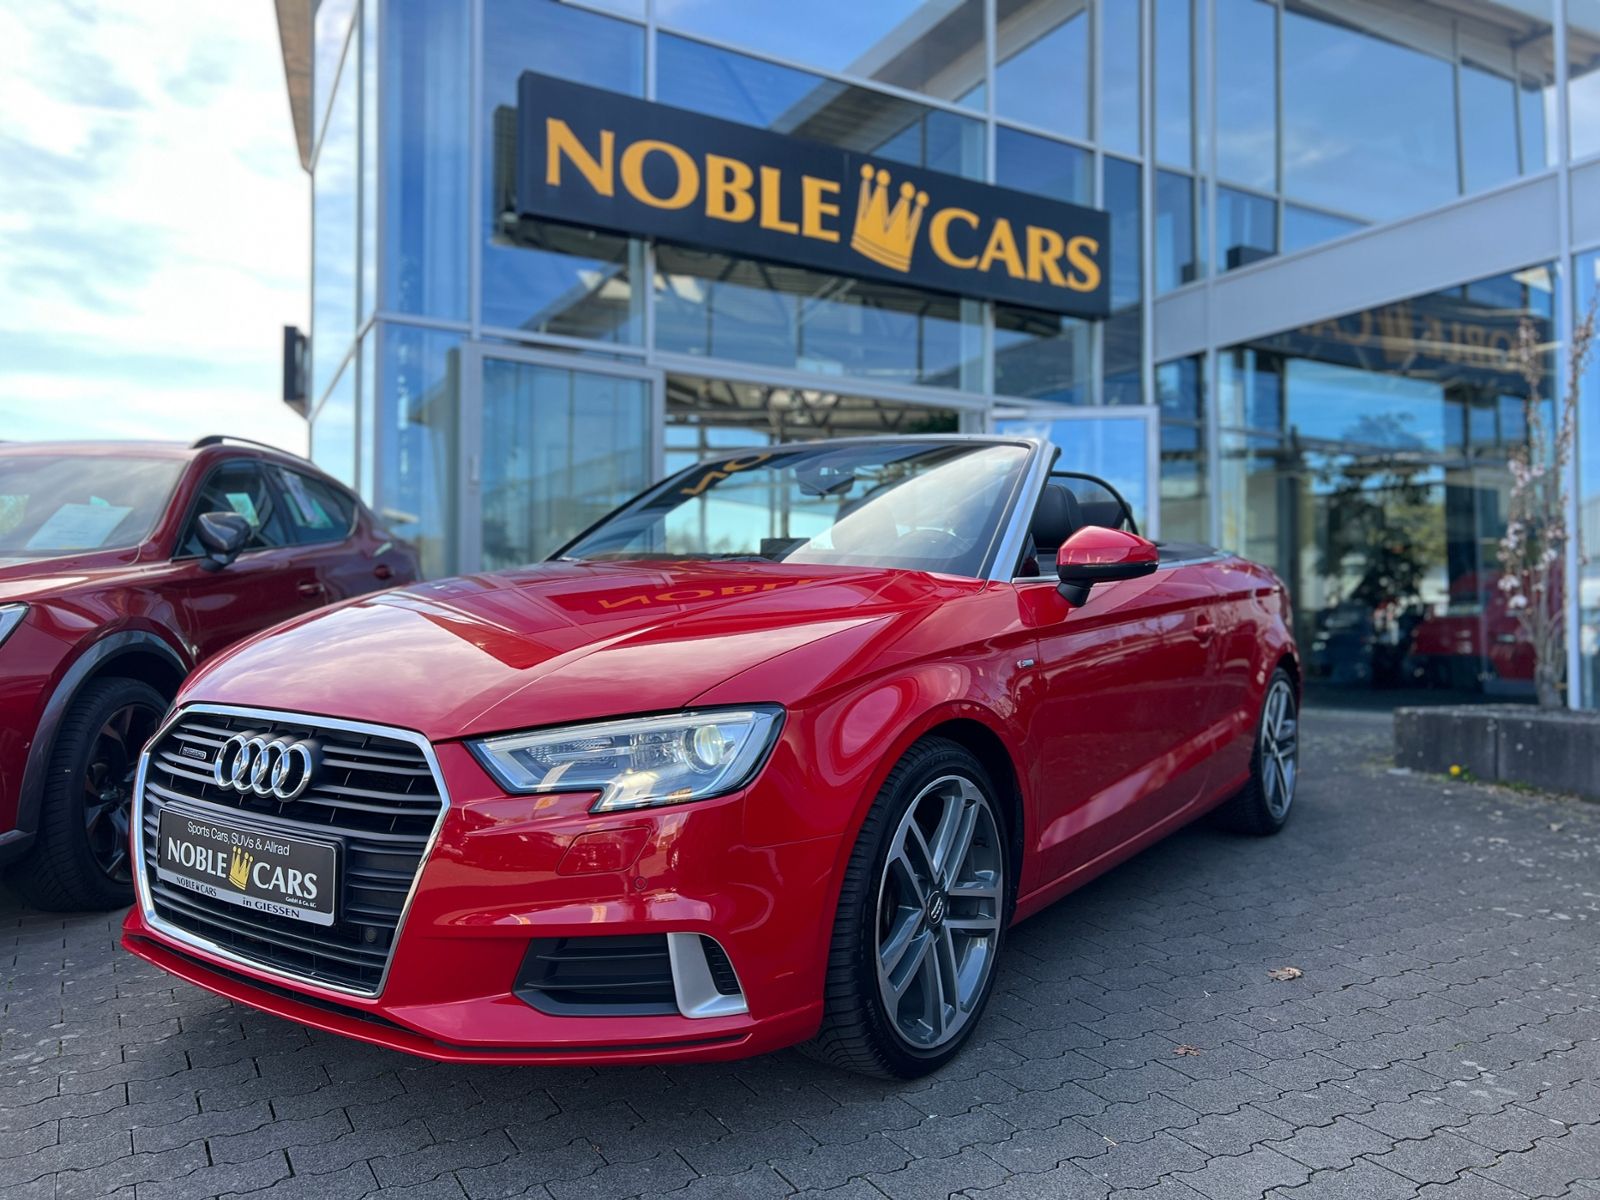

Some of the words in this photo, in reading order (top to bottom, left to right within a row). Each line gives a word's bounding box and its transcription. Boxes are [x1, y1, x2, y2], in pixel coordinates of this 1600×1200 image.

[546, 117, 841, 243] NOBLE
[929, 207, 1101, 293] CARS
[187, 821, 210, 838] Sports
[211, 827, 231, 845] Cars,
[231, 832, 255, 848] SUVs
[255, 839, 264, 850] &
[263, 840, 290, 856] Allrad
[167, 837, 228, 878] NOBLE
[253, 861, 318, 900] CARS
[176, 877, 196, 890] NOBLE
[200, 884, 217, 897] CARS
[242, 898, 253, 907] in
[254, 900, 301, 919] GIESSEN
